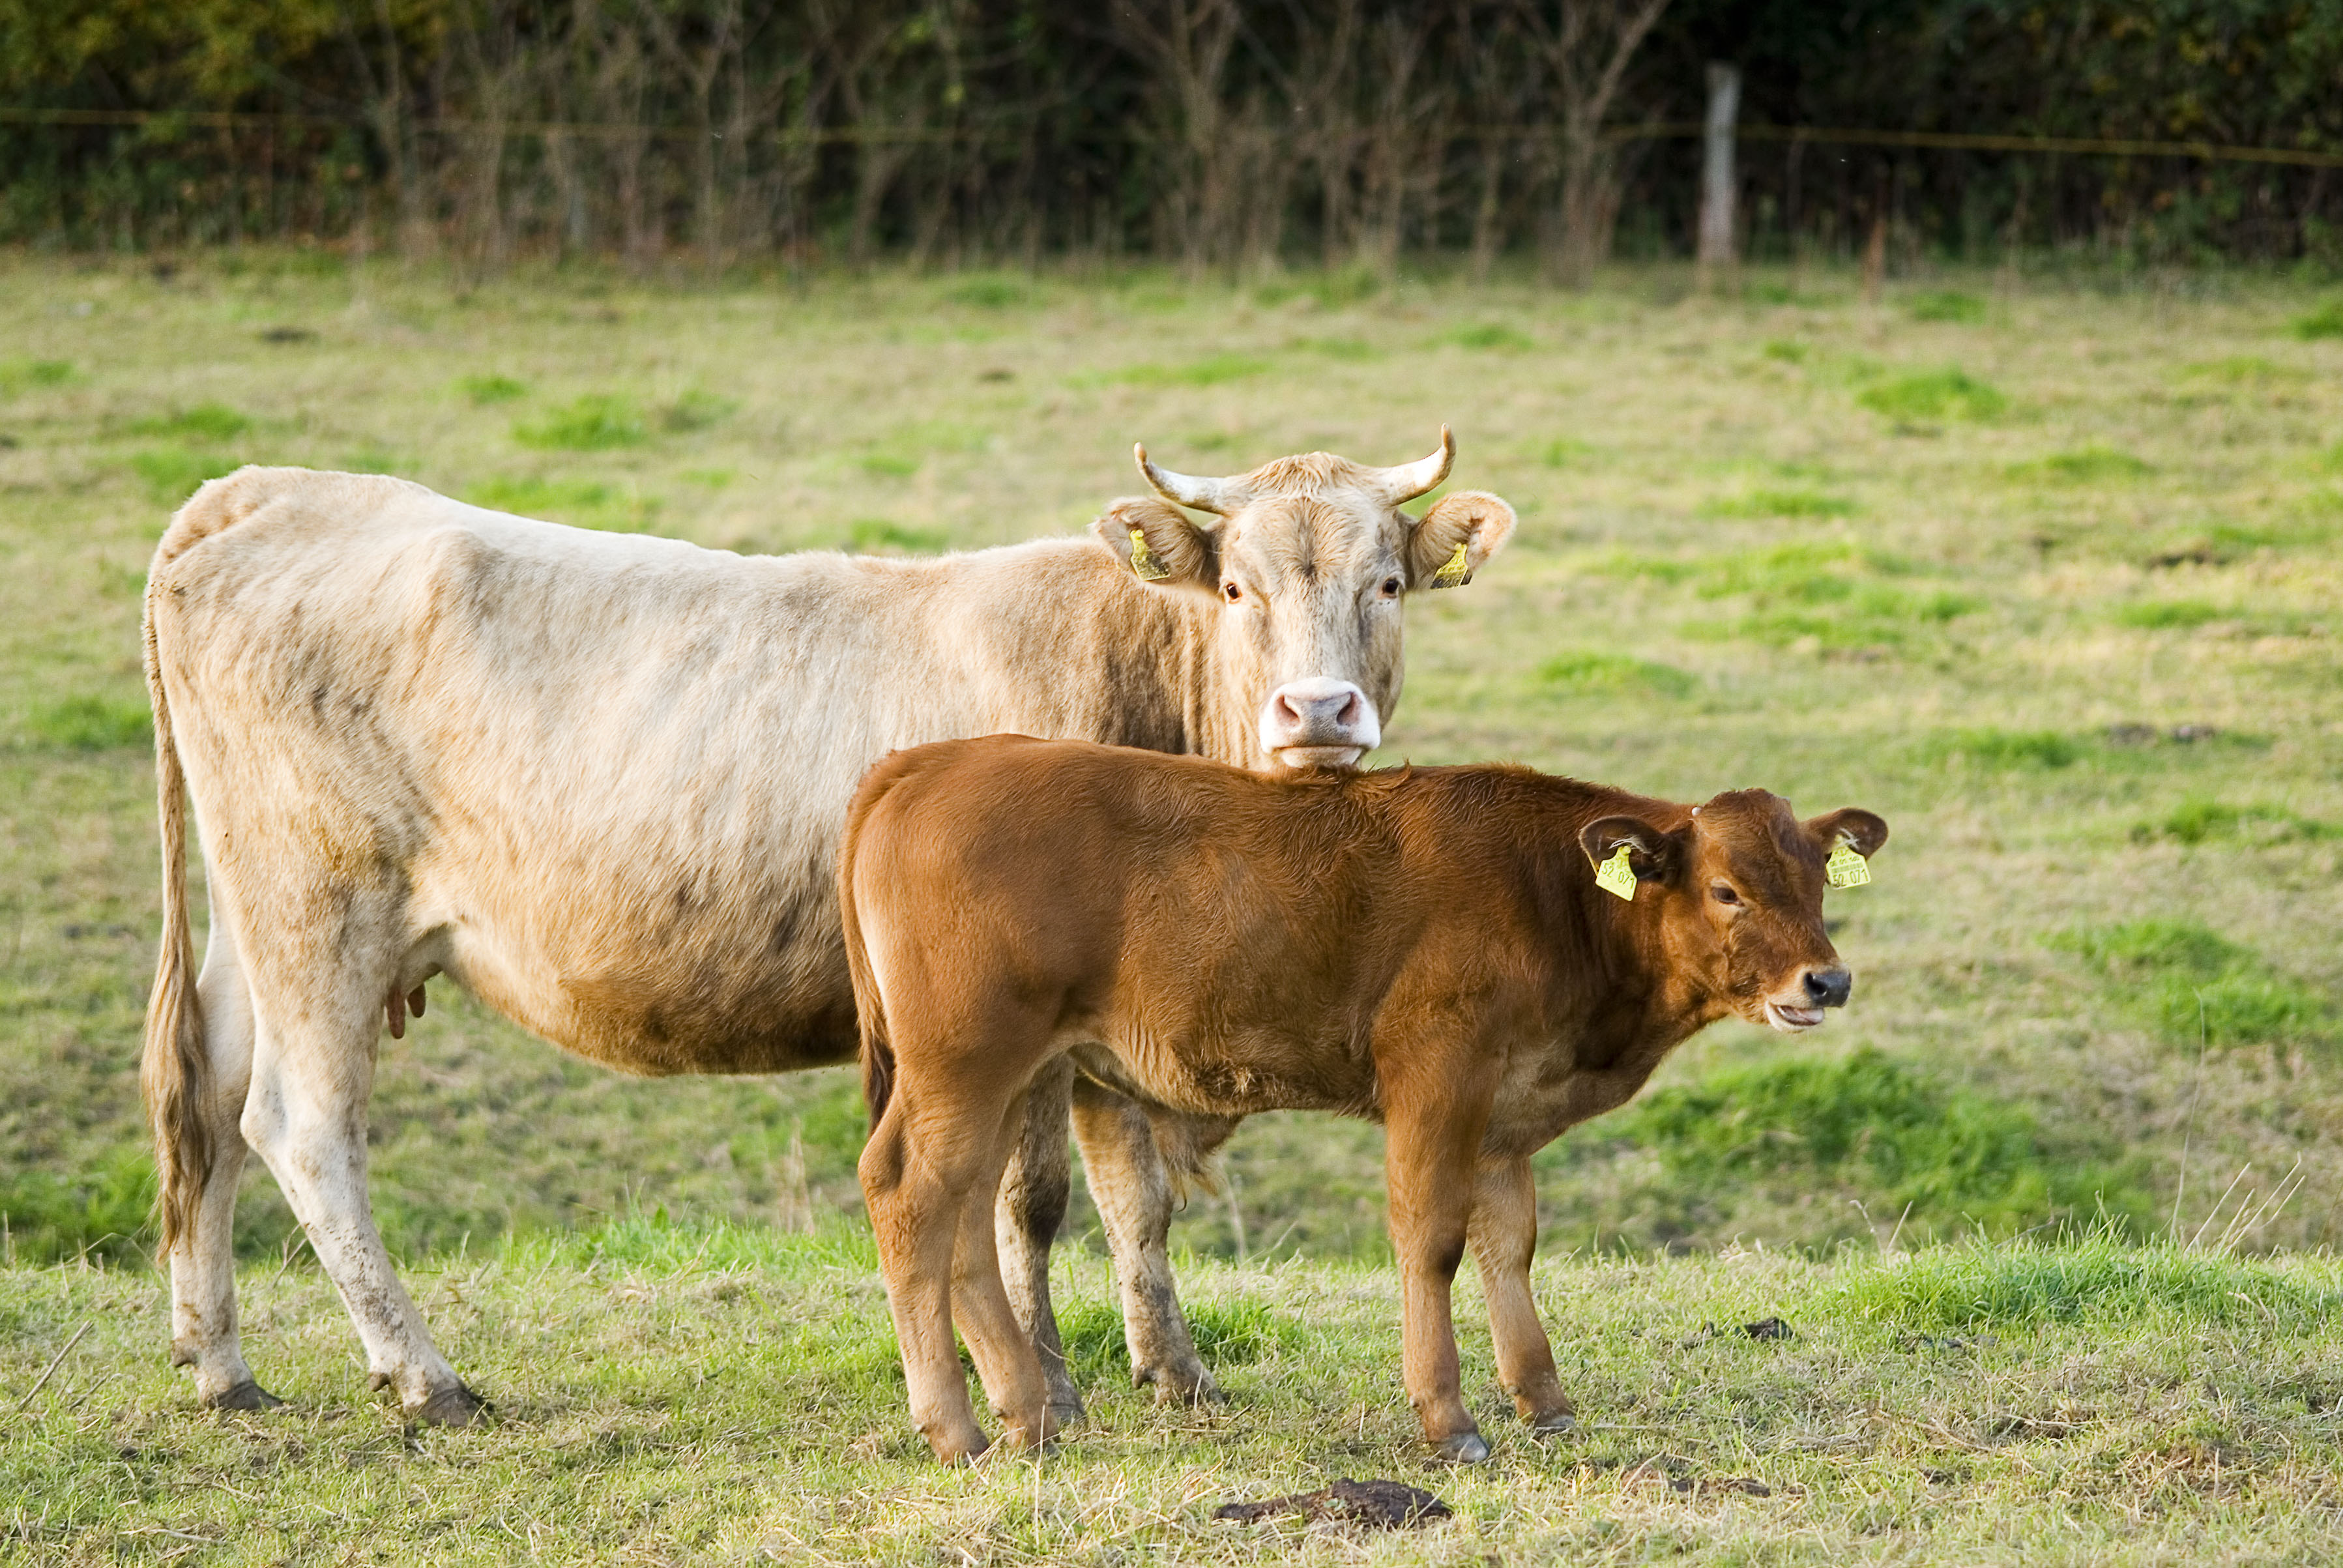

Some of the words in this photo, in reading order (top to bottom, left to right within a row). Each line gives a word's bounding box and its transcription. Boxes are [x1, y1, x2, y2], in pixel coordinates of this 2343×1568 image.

[1602, 863, 1614, 878] 52
[1618, 871, 1635, 889] 071
[1833, 874, 1846, 888] 52
[1850, 869, 1869, 884] 071
